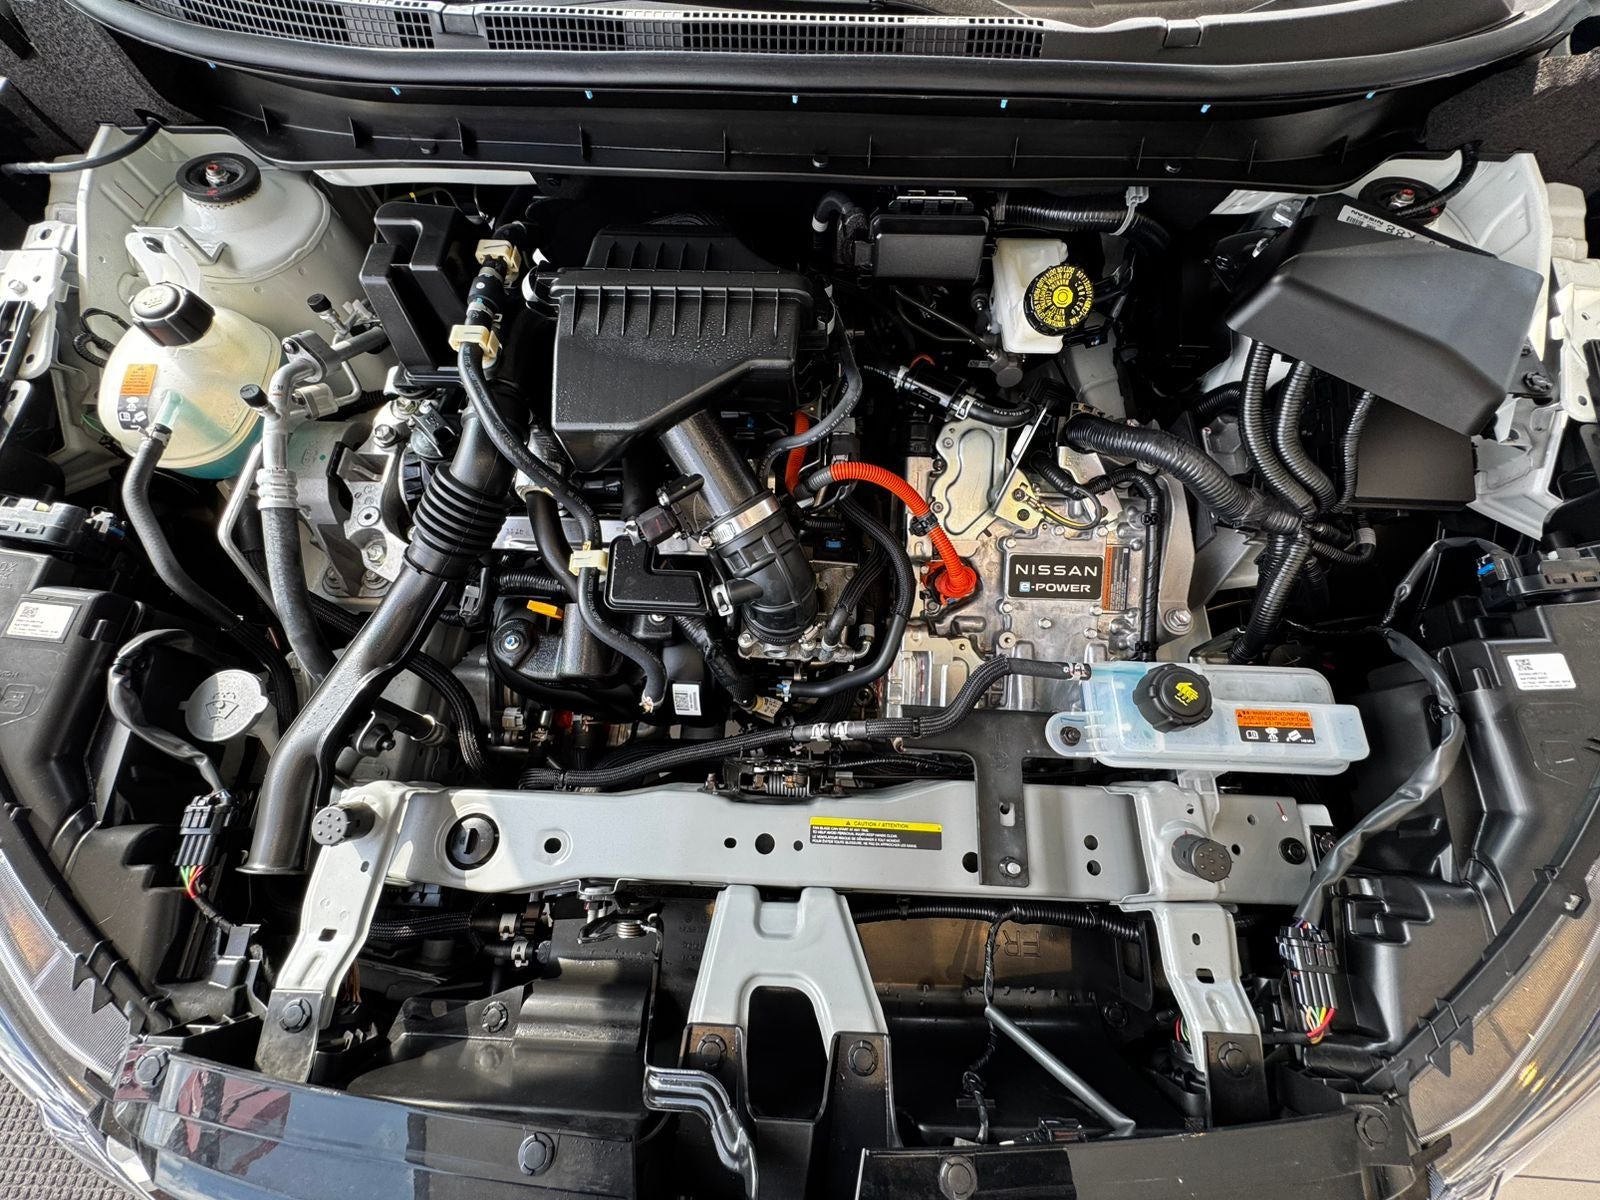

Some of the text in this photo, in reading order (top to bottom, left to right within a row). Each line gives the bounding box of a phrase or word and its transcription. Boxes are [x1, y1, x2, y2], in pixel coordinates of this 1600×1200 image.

[1350, 210, 1384, 225] NISSAN
[1016, 564, 1098, 576] NISSAN
[1020, 582, 1091, 593] e-POWER
